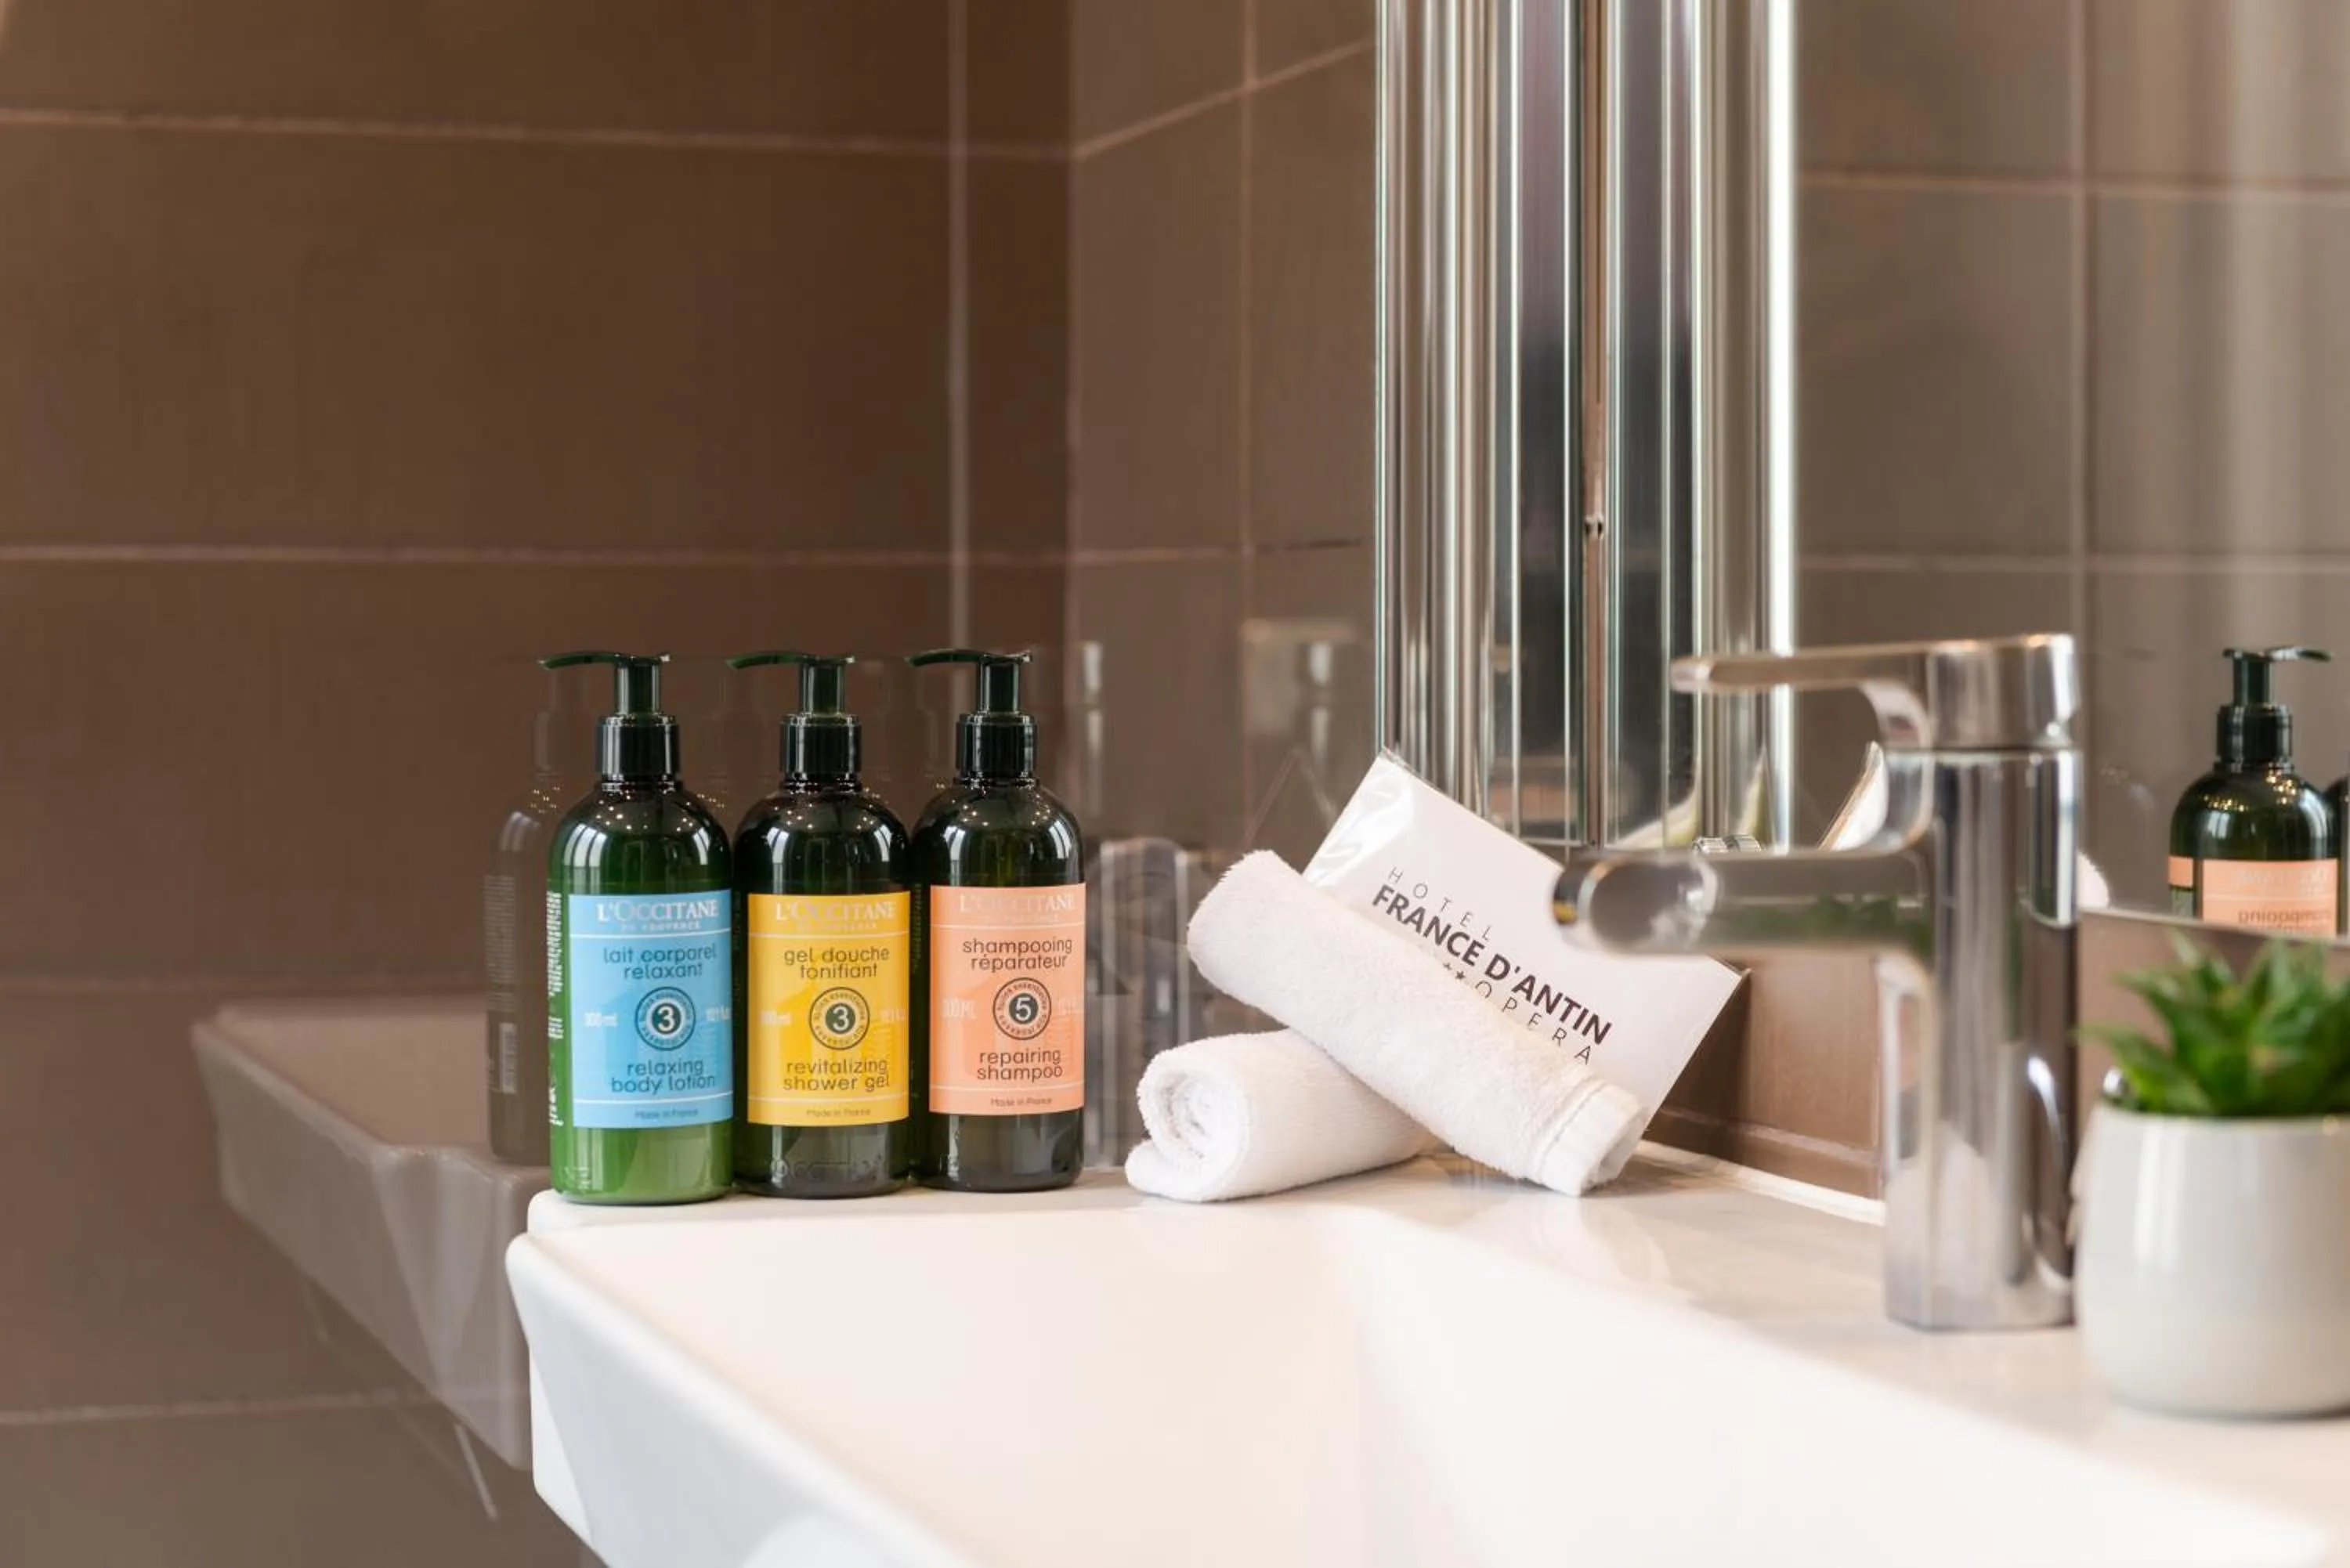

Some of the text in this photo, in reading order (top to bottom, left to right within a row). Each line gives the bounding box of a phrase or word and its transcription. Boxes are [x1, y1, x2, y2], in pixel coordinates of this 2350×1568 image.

[596, 899, 719, 922] L'OCCITANE
[603, 943, 718, 964] lait corporel
[784, 945, 890, 966] gel douche
[962, 935, 1073, 956] shampooing
[624, 963, 703, 980] relaxant
[800, 963, 878, 979] tonifiant
[971, 954, 1068, 973] réparateur
[1372, 884, 1612, 1046] FRANCE D'ANTIN
[657, 1006, 675, 1031] 3
[833, 1006, 850, 1031] 3
[1014, 996, 1032, 1021] 5
[627, 1058, 703, 1076] relaxing
[786, 1058, 888, 1075] revitalizing
[979, 1046, 1061, 1067] repairing
[783, 1071, 890, 1093] shower gel
[977, 1064, 1064, 1083] shampoo
[611, 1074, 715, 1096] body lotion
